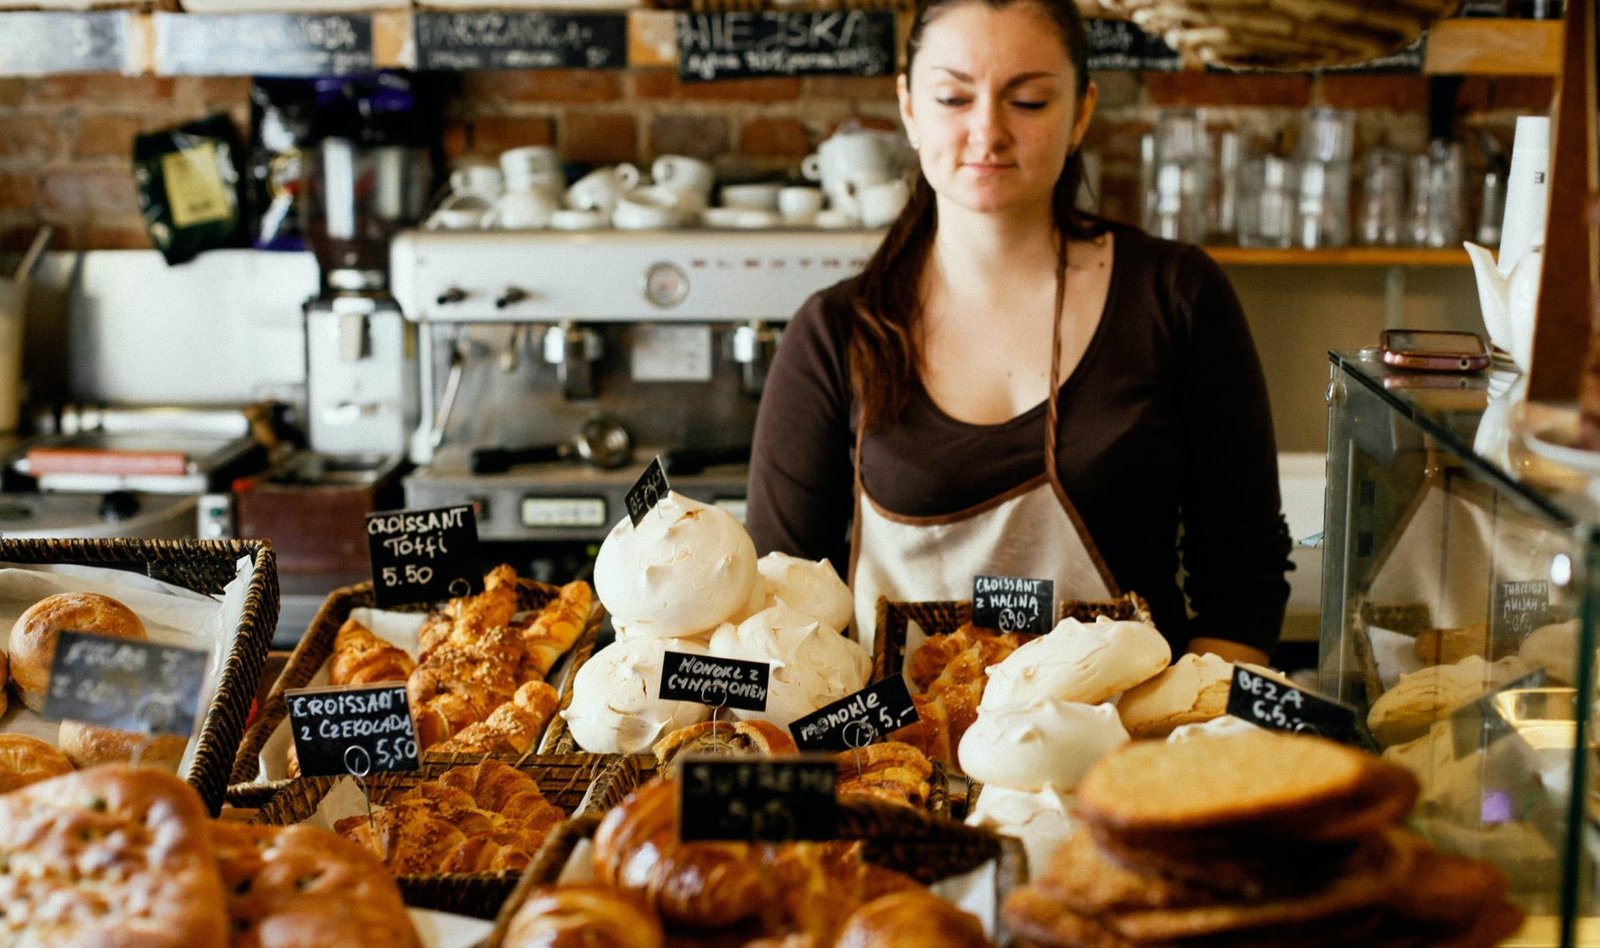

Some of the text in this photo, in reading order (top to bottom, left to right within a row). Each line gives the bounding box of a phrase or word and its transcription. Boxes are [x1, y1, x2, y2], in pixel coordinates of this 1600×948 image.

[368, 507, 468, 535] CROISSANT
[383, 565, 433, 587] 5.50
[976, 577, 1042, 595] CROISSANT
[293, 690, 406, 718] CROISSANT
[801, 692, 881, 741] monokle
